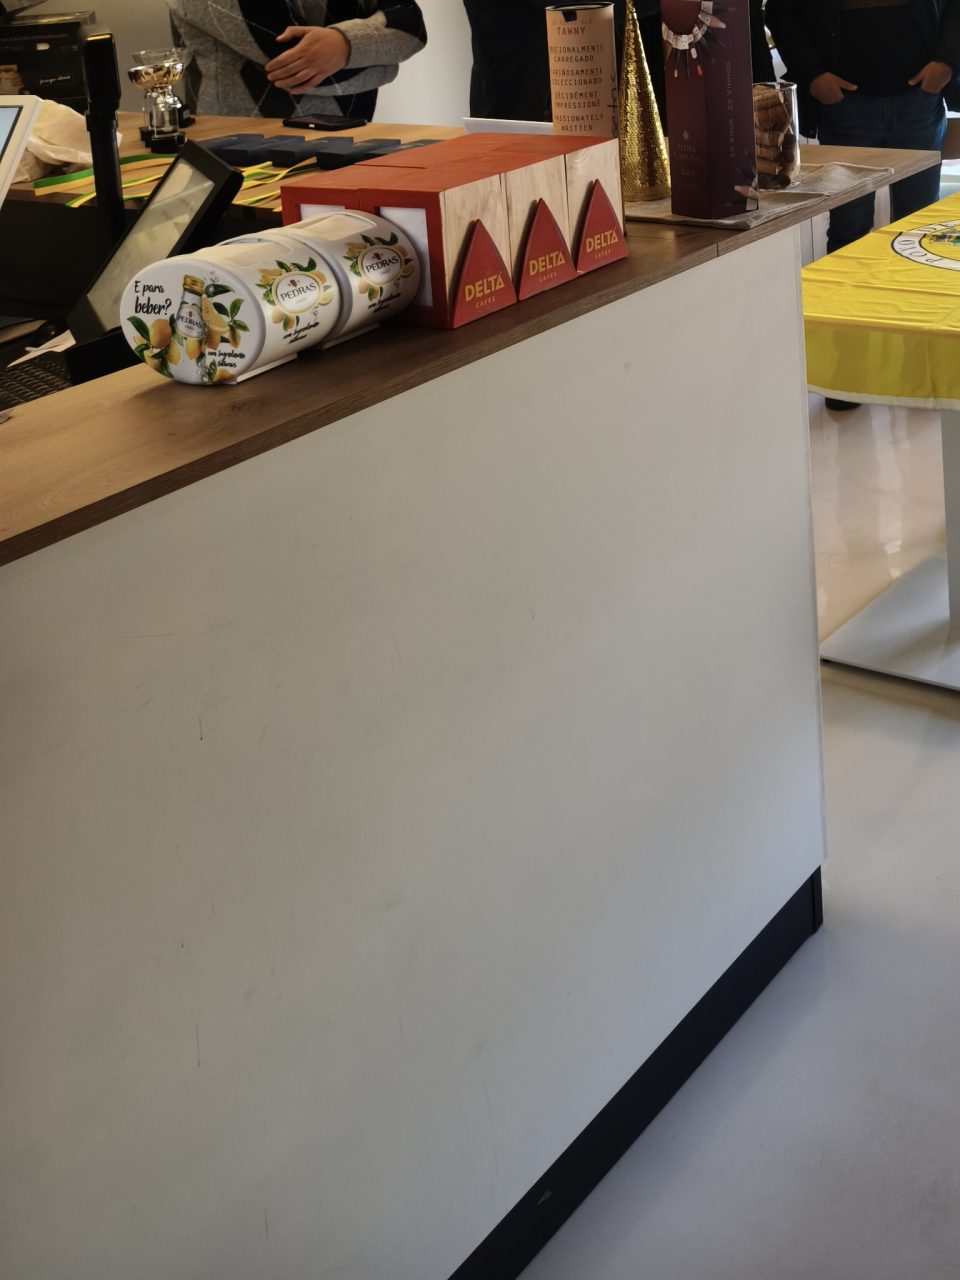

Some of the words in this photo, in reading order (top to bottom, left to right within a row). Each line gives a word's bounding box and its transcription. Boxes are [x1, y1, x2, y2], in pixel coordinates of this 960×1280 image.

[557, 26, 586, 36] TAWNY
[554, 55, 594, 63] CARREGADO
[561, 124, 593, 133] WRITTEN
[586, 229, 620, 253] DELTA
[365, 255, 399, 273] PEDRAS
[529, 250, 566, 276] DELTA
[134, 280, 141, 293] E
[142, 283, 166, 297] para
[280, 282, 317, 301] PEDRAS
[464, 271, 505, 302] DELTA
[134, 296, 172, 316] beber?
[176, 314, 203, 329] PEDRAS
